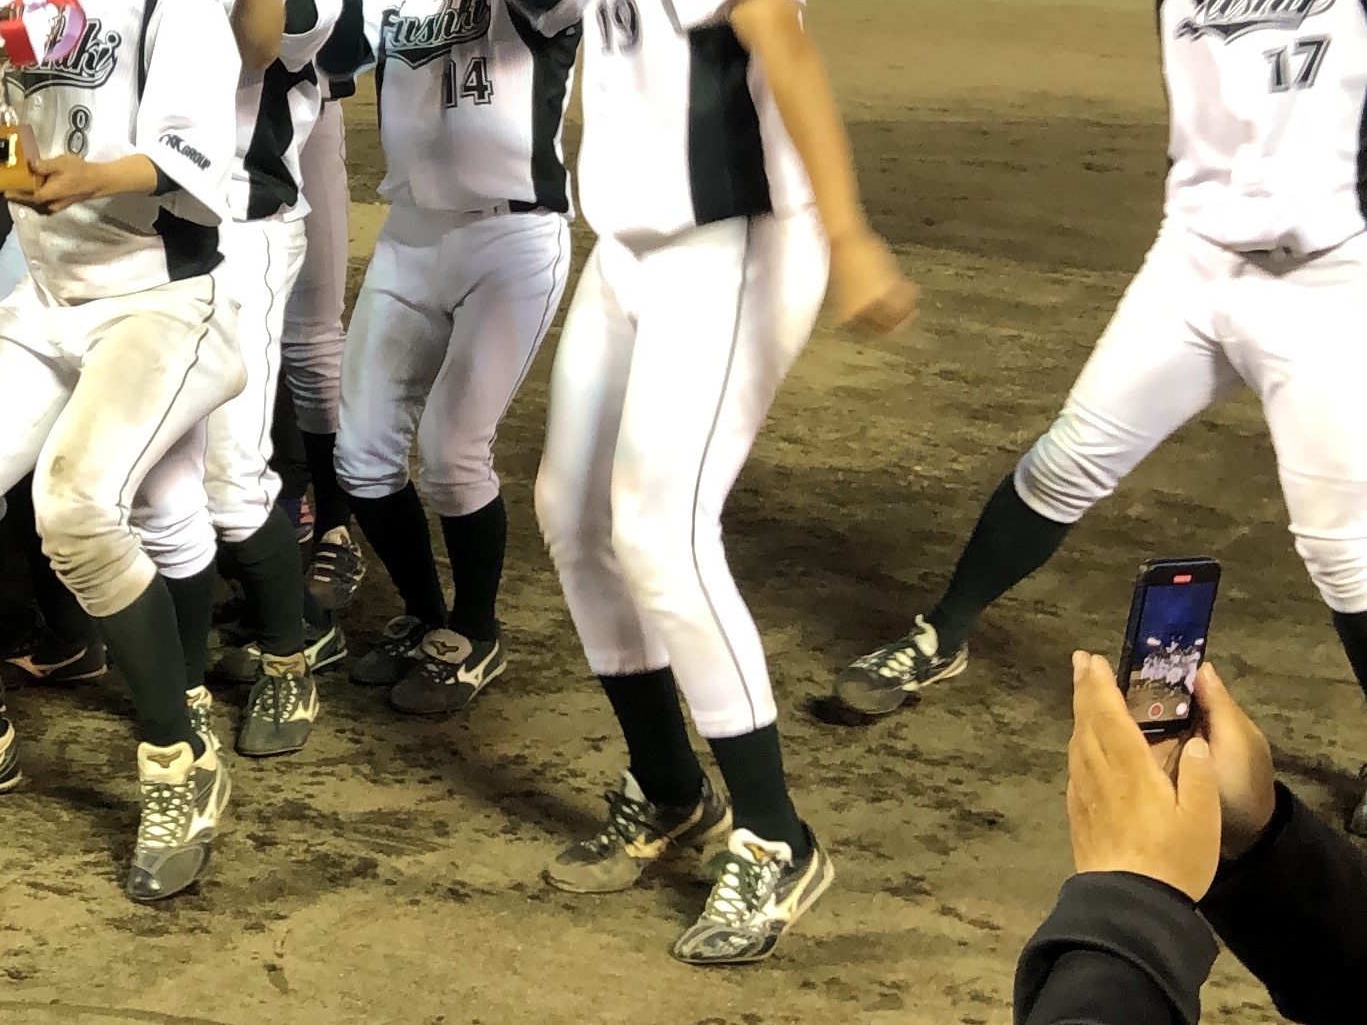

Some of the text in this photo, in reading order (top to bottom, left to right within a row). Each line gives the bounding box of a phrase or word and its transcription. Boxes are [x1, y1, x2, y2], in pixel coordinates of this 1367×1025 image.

[443, 55, 495, 110] 14
[1261, 33, 1332, 94] 17
[67, 104, 93, 158] 8
